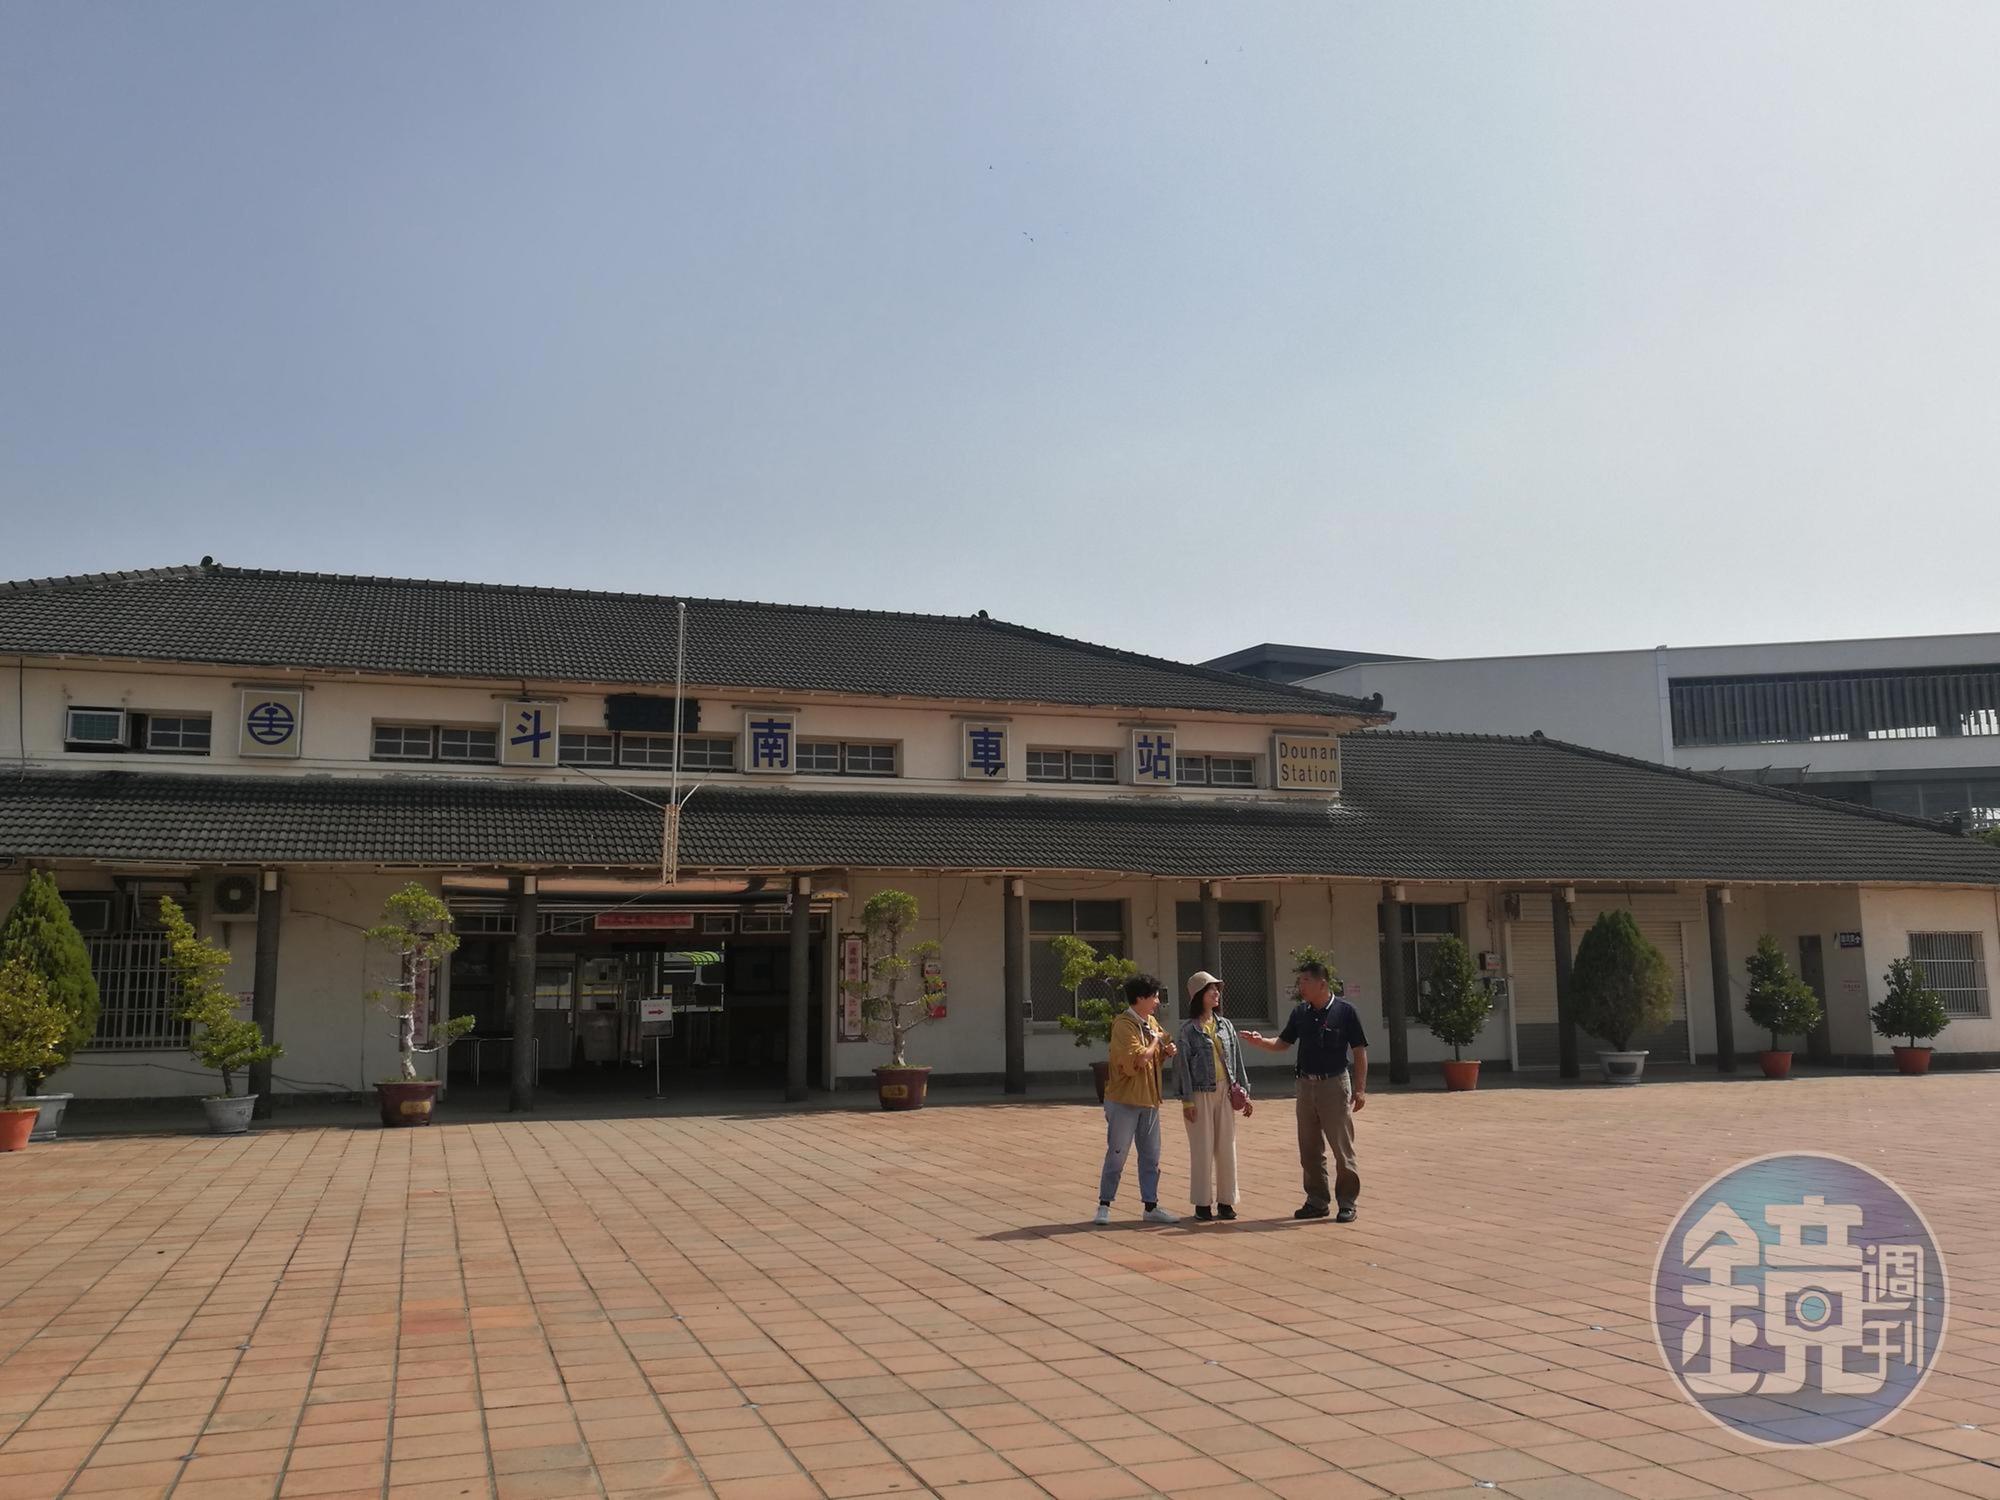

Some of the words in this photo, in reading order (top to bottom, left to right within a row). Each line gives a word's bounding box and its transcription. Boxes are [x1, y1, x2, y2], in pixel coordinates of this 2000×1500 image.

[511, 709, 551, 758] 斗
[750, 718, 791, 768] 南
[968, 727, 1005, 775] 車
[1137, 735, 1171, 779] 站
[1280, 742, 1337, 760] Dounan
[1281, 763, 1337, 783] Station
